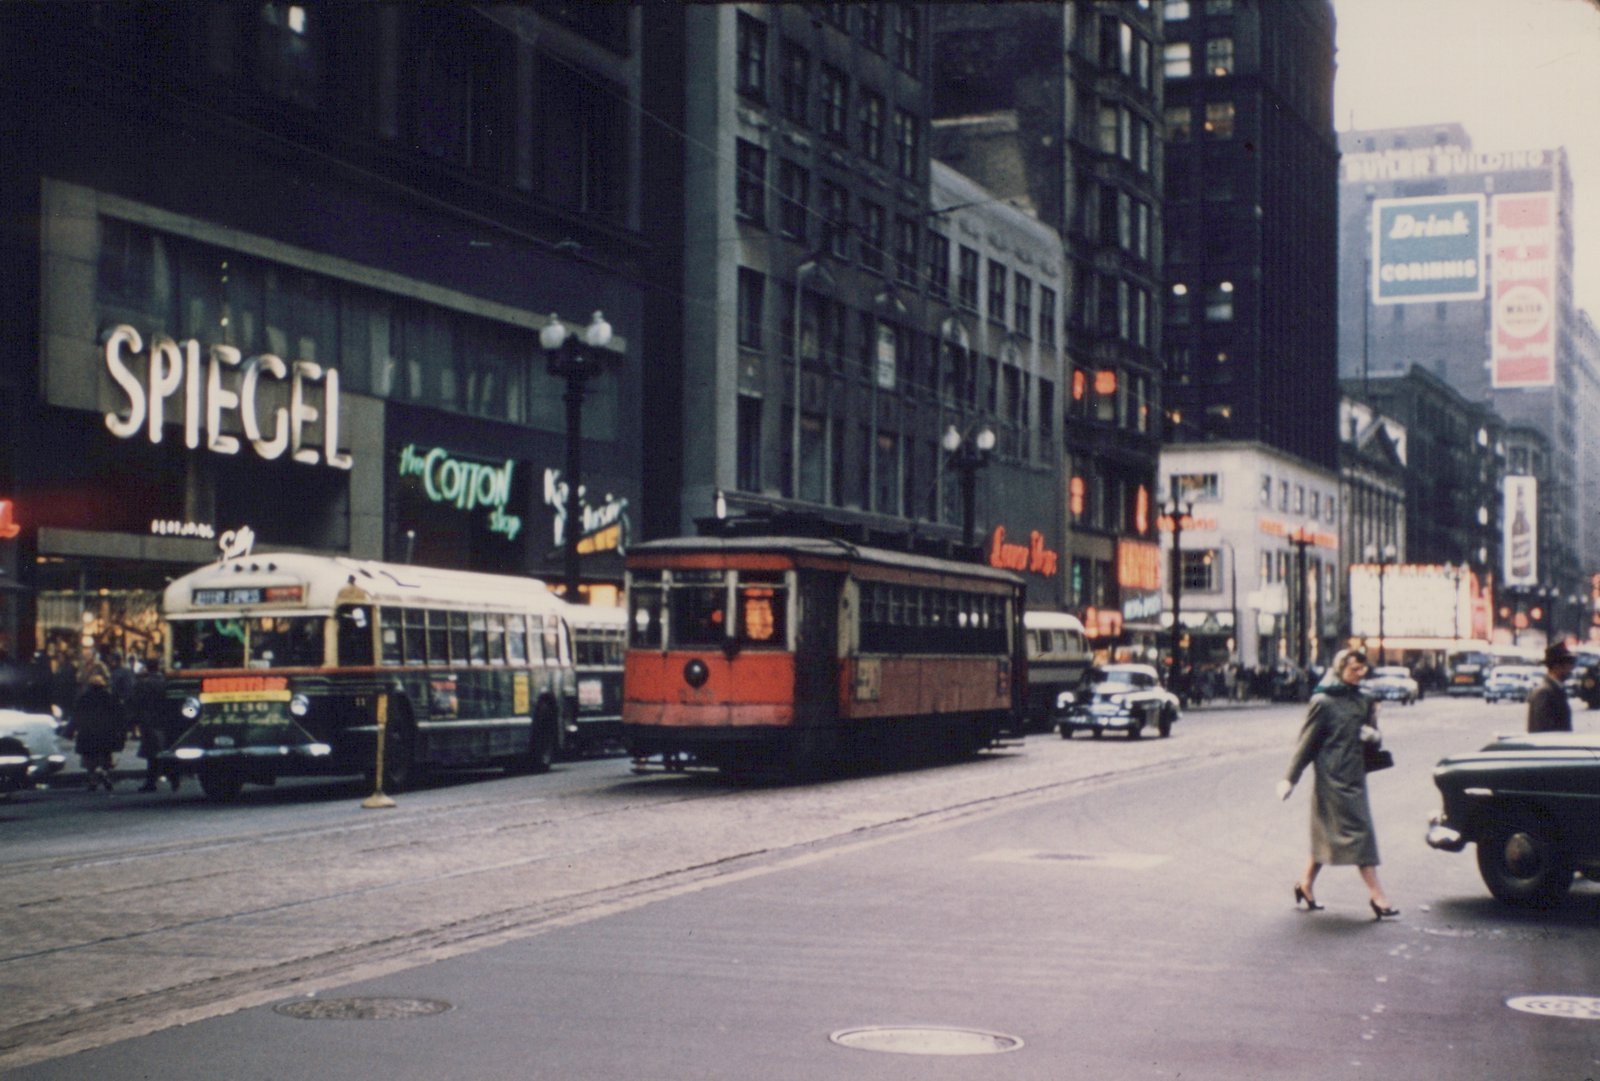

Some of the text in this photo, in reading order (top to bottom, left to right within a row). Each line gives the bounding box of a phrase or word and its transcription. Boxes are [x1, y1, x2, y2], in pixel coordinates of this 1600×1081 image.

[1433, 148, 1544, 176] BUILDING
[1389, 211, 1470, 239] Drink
[105, 324, 353, 470] SPIEGEL
